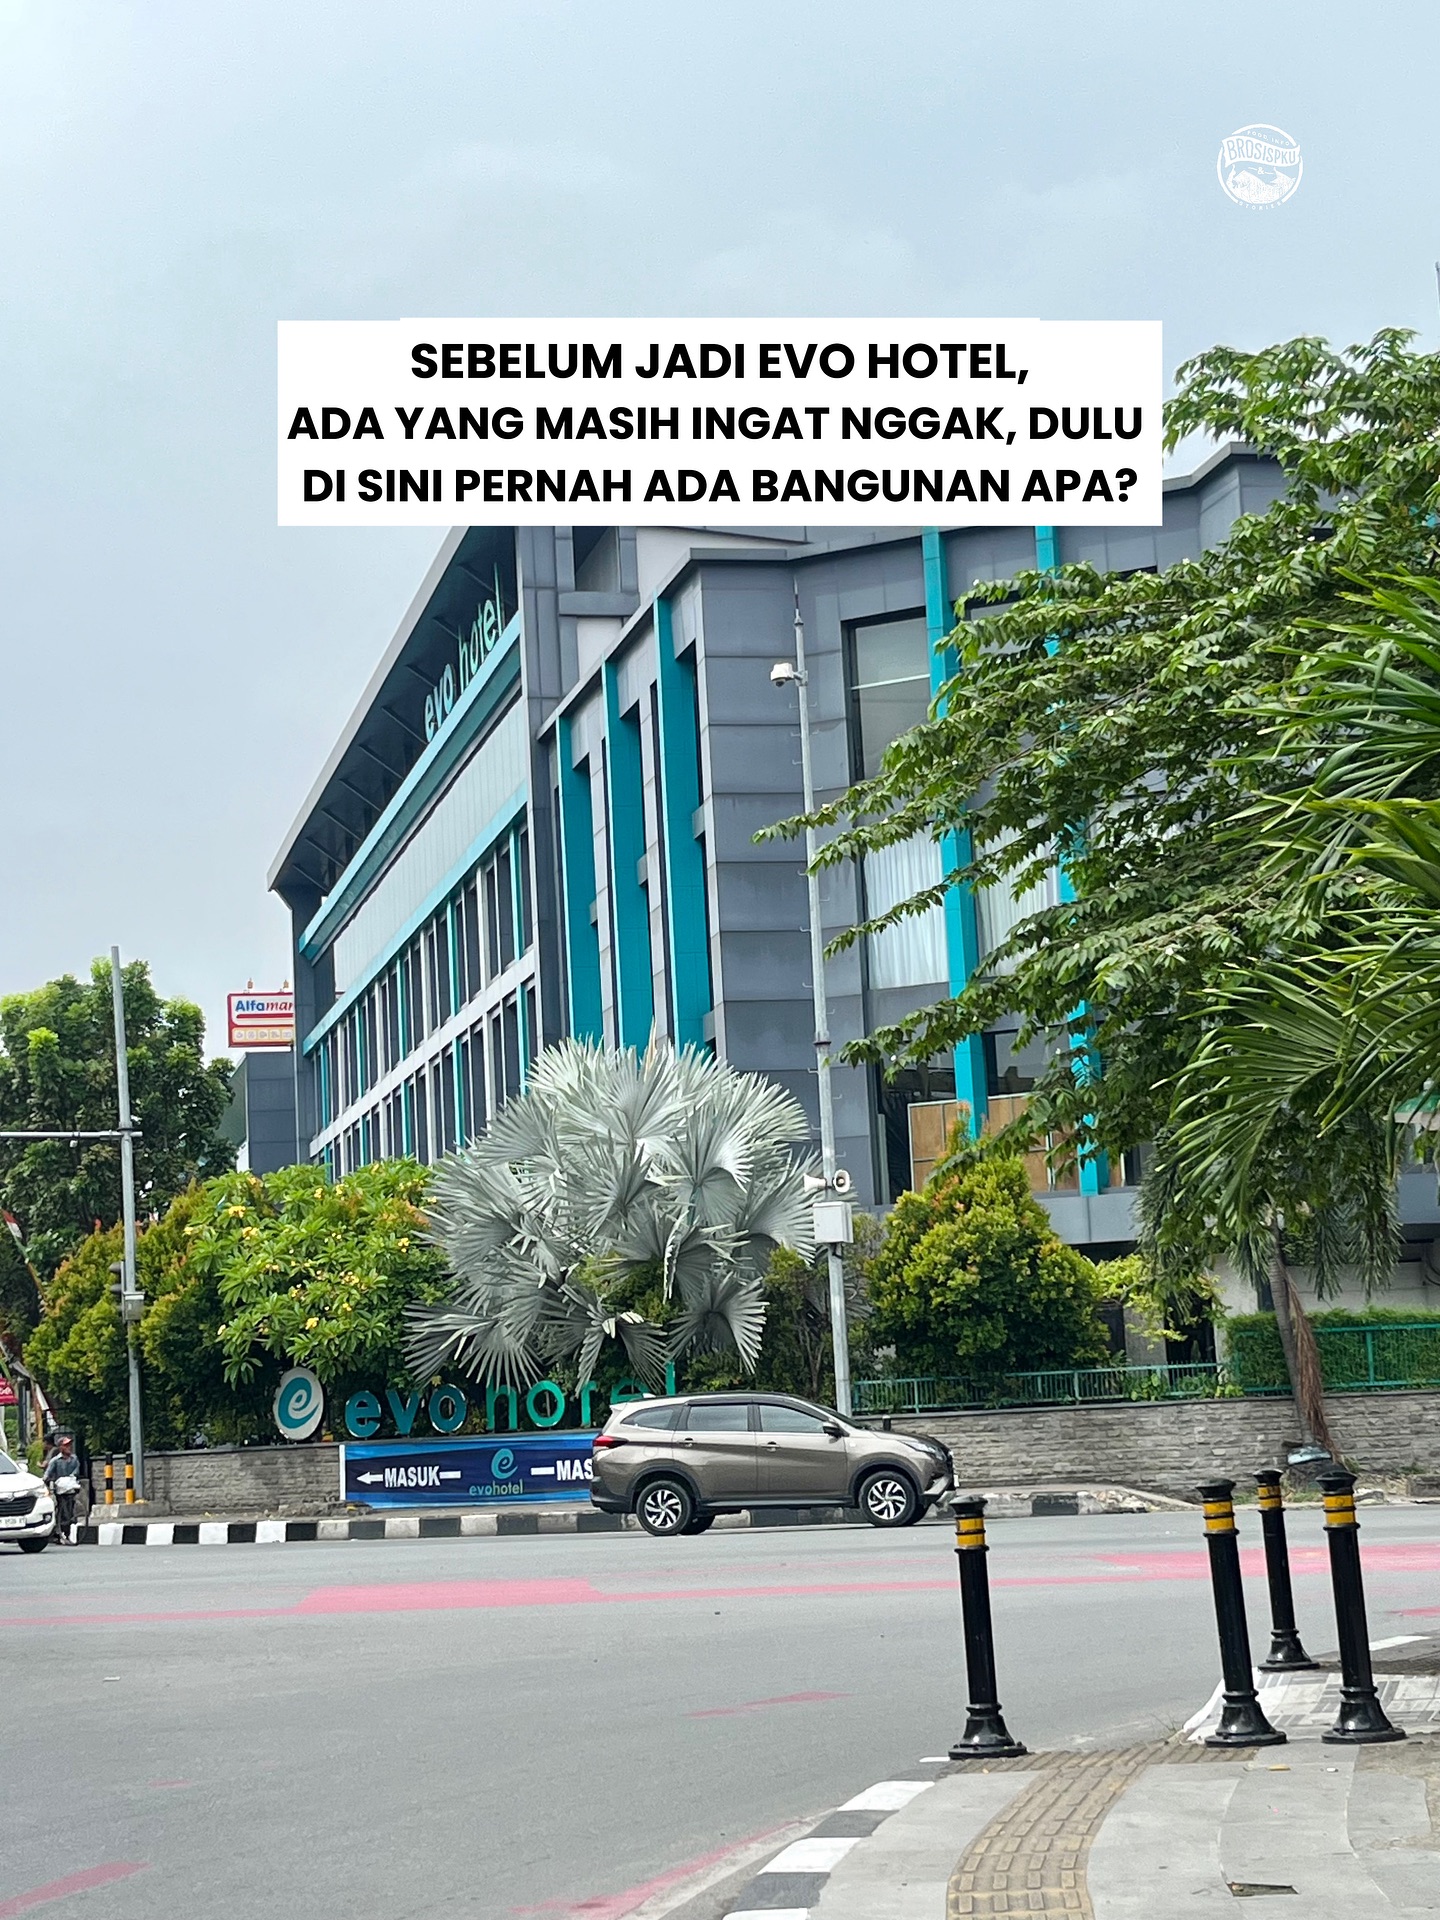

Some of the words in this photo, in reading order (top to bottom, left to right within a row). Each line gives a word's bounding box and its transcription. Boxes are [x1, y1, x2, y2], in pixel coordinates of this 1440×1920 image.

[424, 663, 455, 743] evo
[458, 562, 504, 695] hotel
[345, 1383, 467, 1438] evo
[384, 1465, 441, 1488] MASUK
[469, 1478, 524, 1497] evohotel
